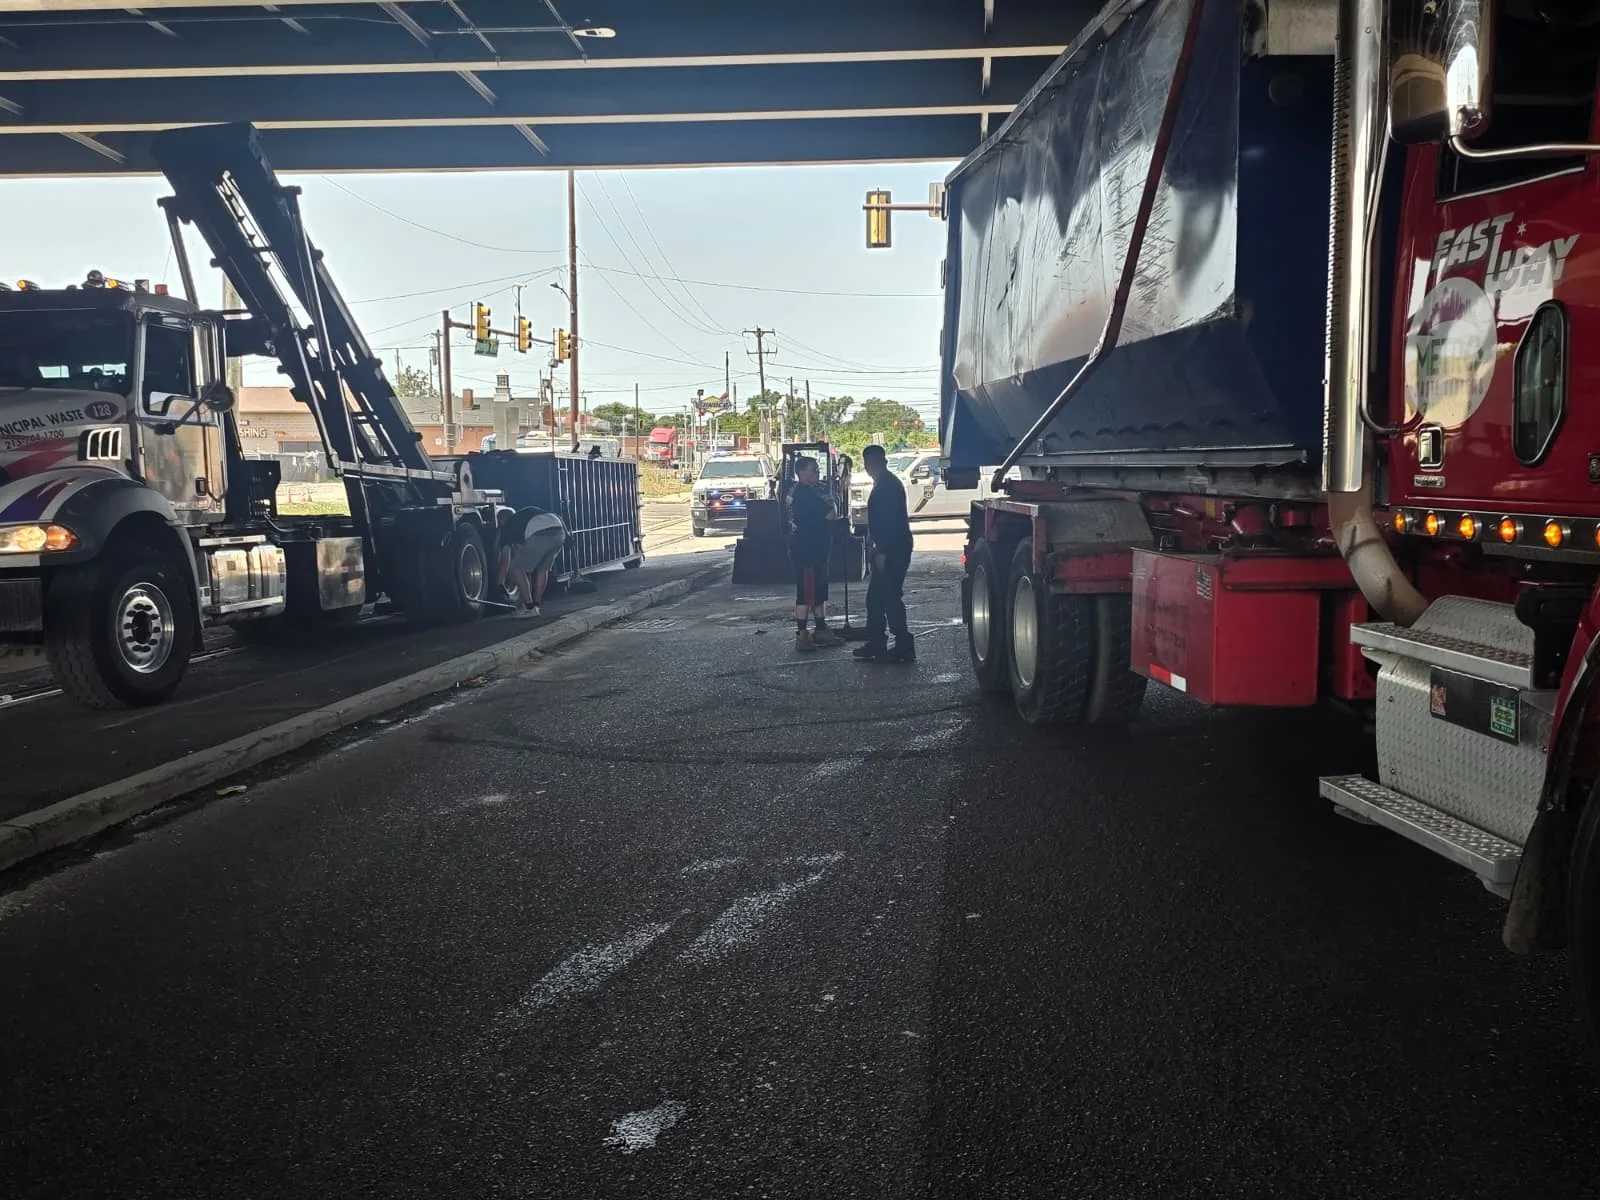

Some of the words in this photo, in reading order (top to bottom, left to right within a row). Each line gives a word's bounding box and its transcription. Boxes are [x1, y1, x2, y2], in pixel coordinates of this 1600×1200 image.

[1484, 233, 1580, 293] WAY
[46, 408, 85, 425] WASTE
[93, 403, 112, 417] 128
